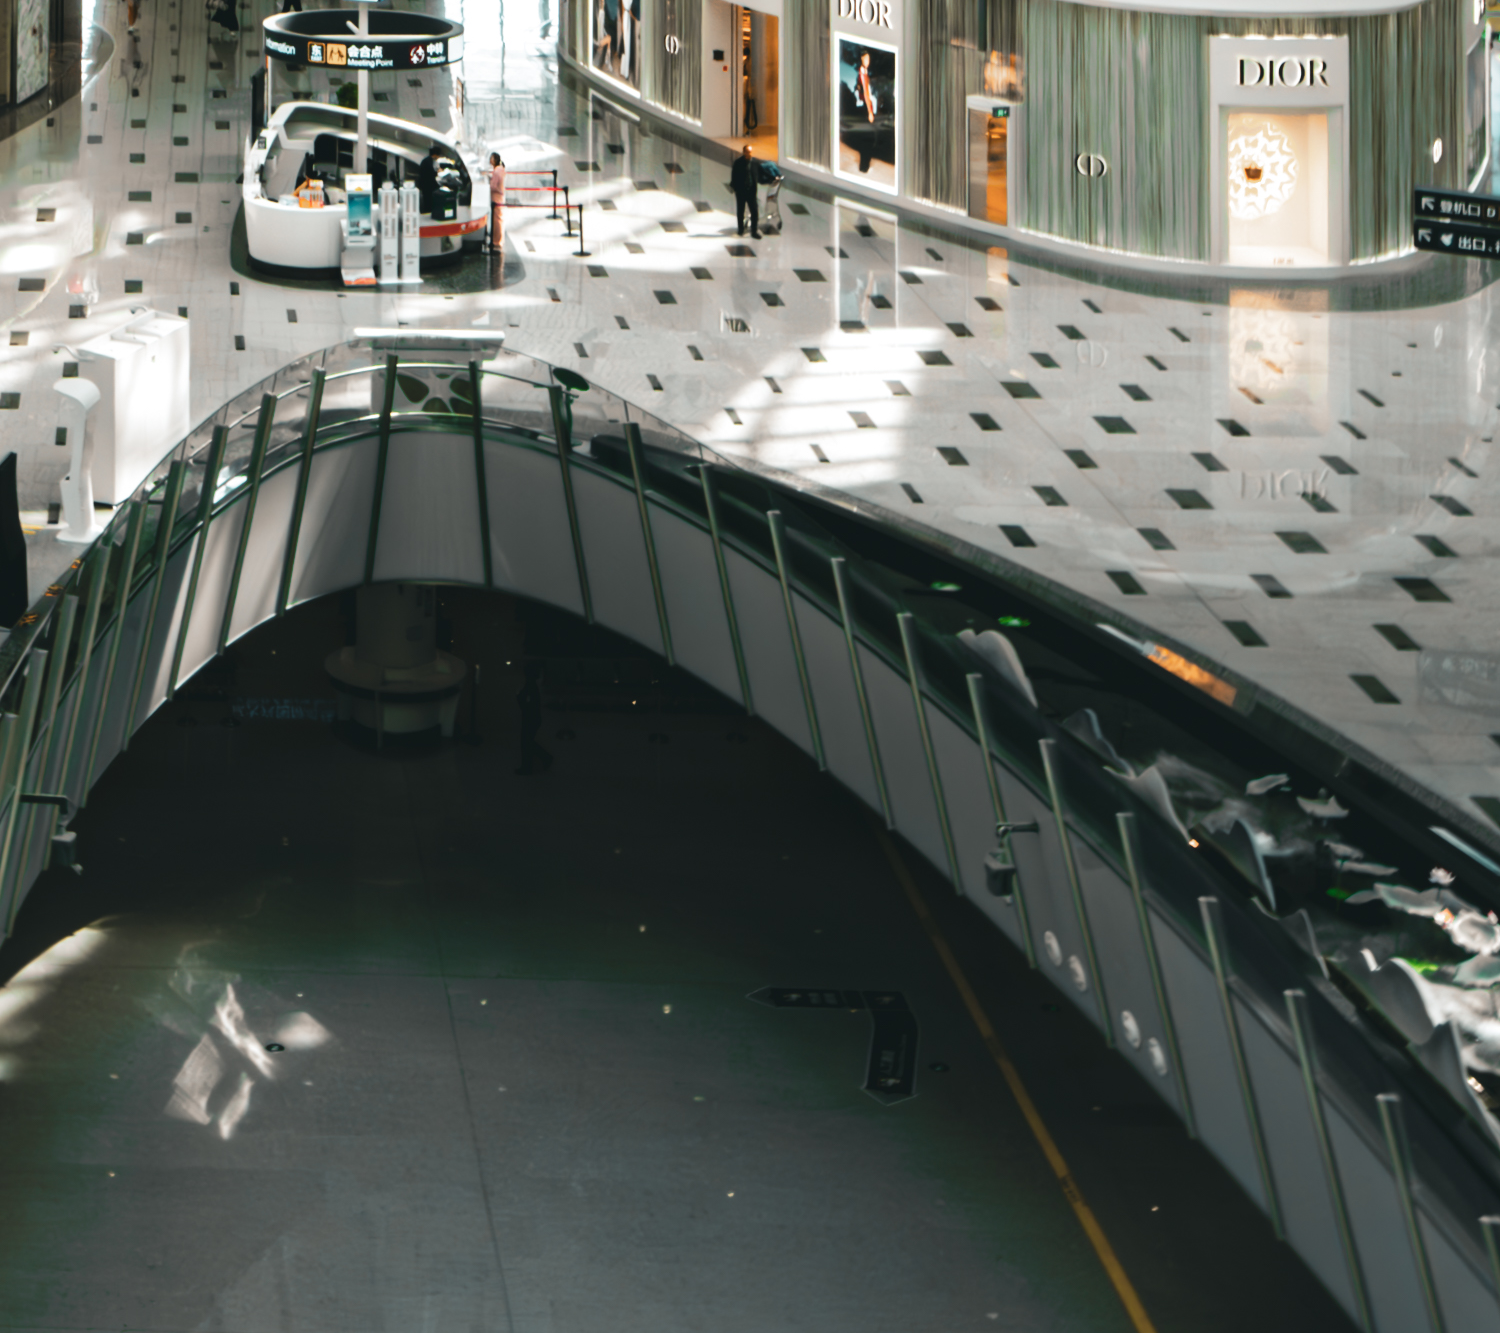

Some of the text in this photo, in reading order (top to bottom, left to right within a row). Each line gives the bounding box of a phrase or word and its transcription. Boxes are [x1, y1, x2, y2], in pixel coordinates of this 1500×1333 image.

[347, 44, 384, 58] 会合点
[347, 58, 394, 68] Meeting Point
[1236, 55, 1329, 88] DIOR
[1440, 199, 1481, 218] 登机口
